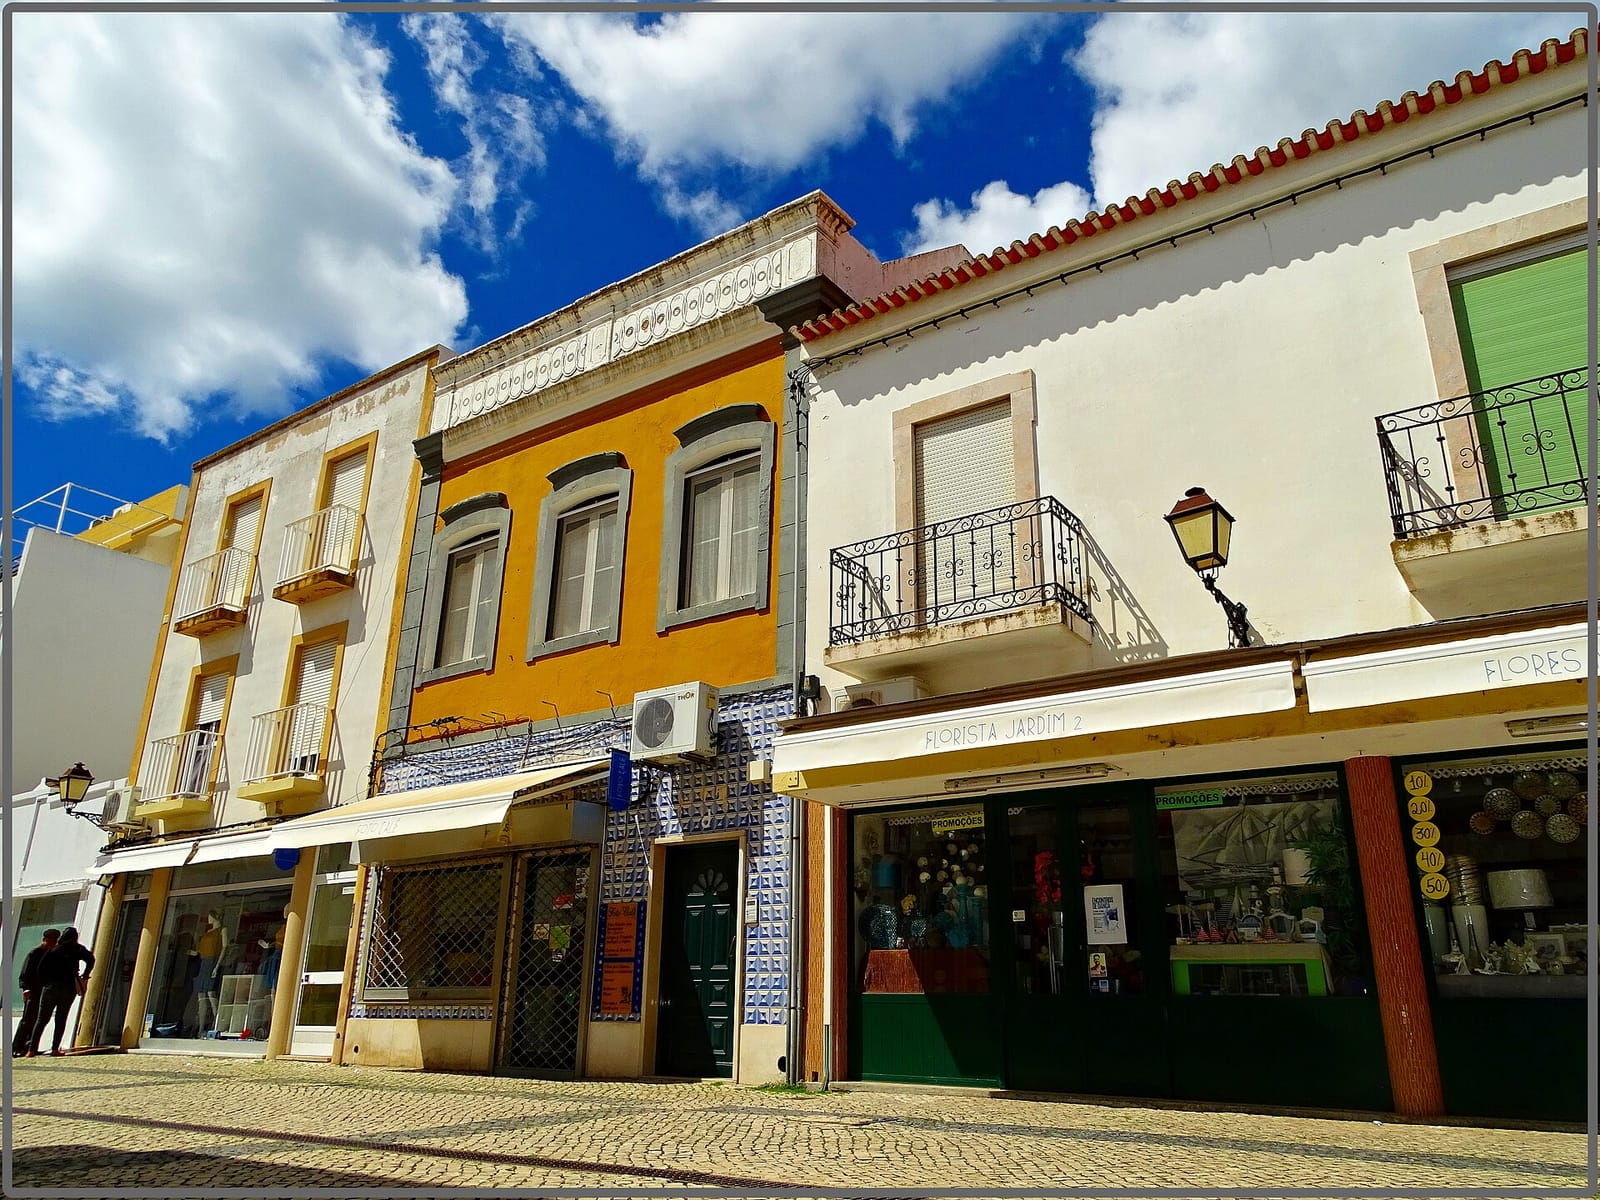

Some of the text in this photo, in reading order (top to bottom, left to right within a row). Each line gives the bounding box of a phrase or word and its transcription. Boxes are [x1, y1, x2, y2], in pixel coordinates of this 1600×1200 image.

[1484, 648, 1582, 683] FLORES
[677, 691, 695, 701] THOR
[925, 722, 998, 750] FLORISTA
[1074, 715, 1083, 731] 2
[1156, 792, 1219, 806] PROMOÇÕES
[932, 815, 983, 828] PROMOÇÕES
